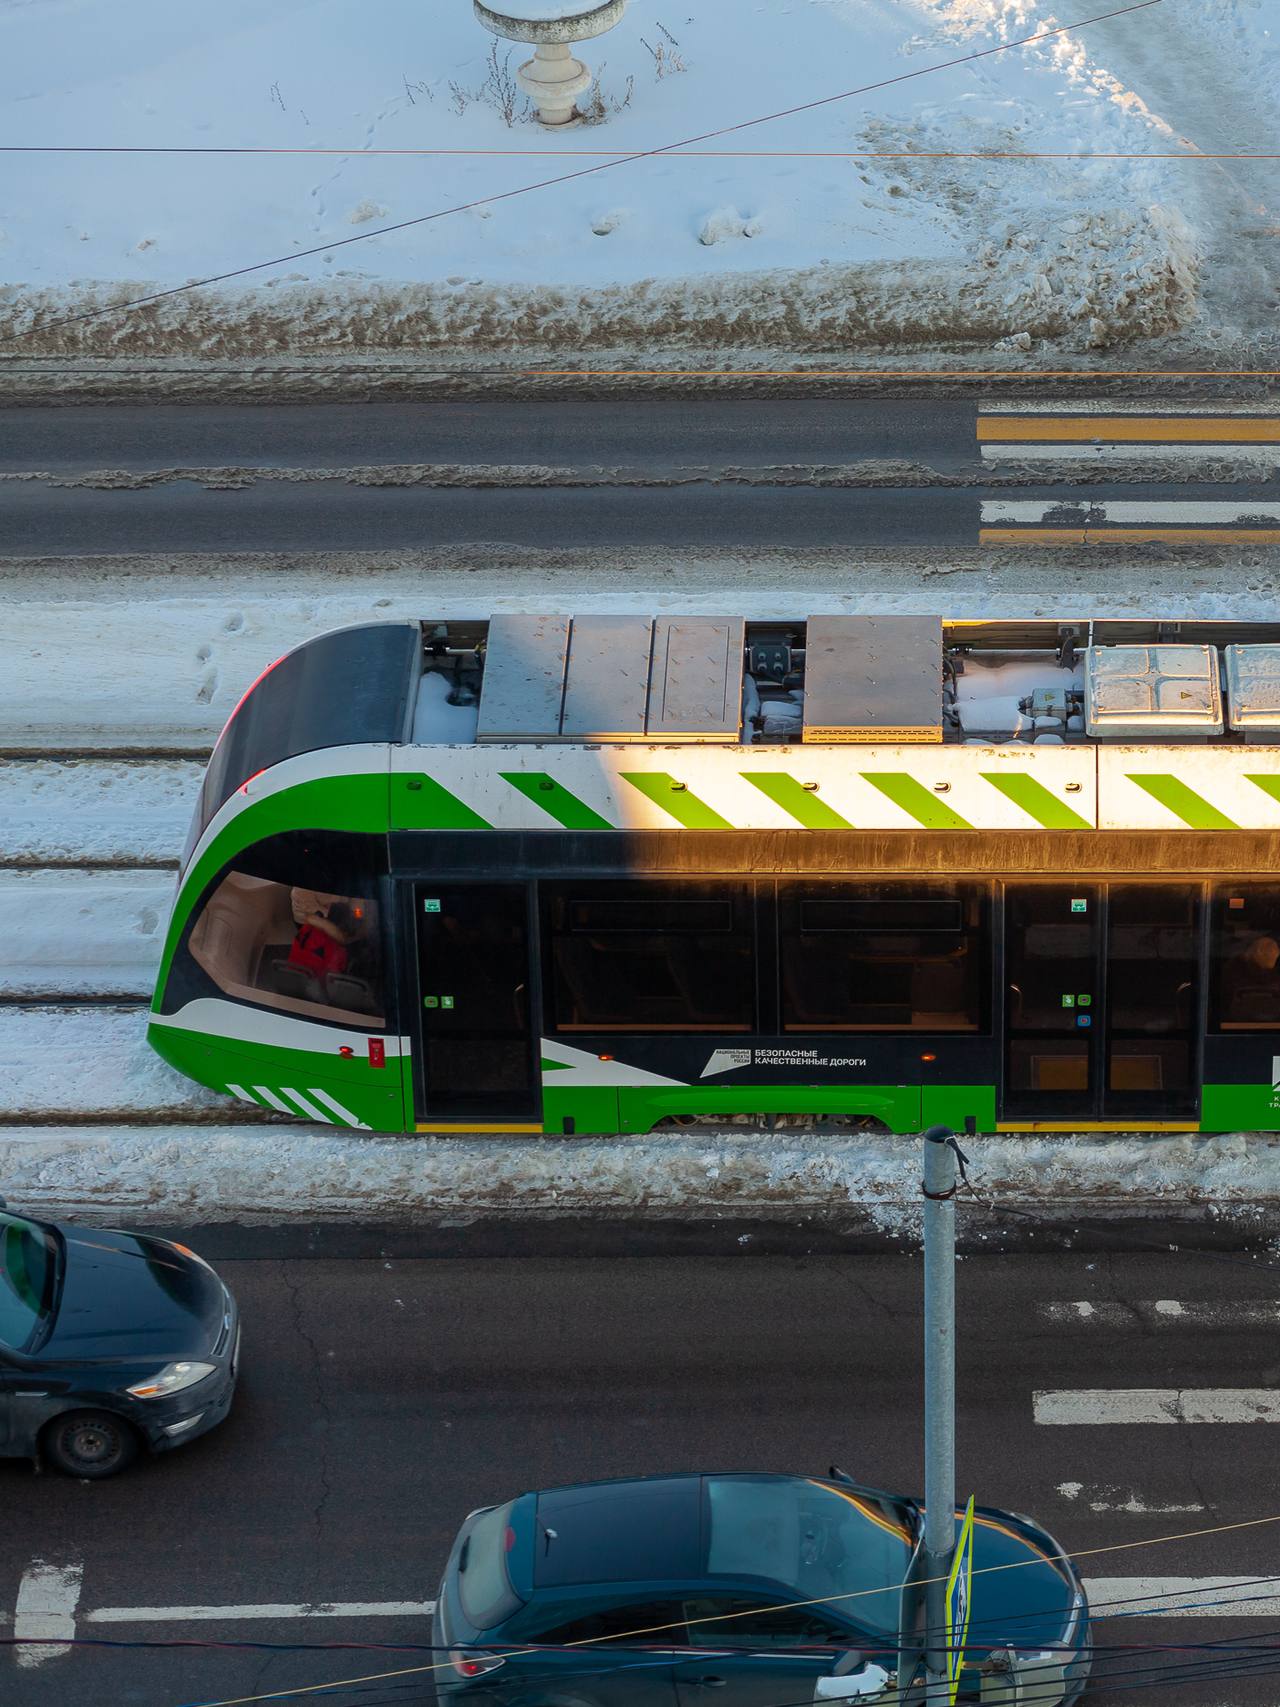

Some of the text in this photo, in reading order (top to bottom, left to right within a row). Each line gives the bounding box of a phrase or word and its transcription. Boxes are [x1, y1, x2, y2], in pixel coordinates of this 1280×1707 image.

[755, 1049, 818, 1057] БЕЗОПАСНЫЕ
[755, 1057, 866, 1067] КАЧЕСТВЕННЫЕ ДОРОГИ
